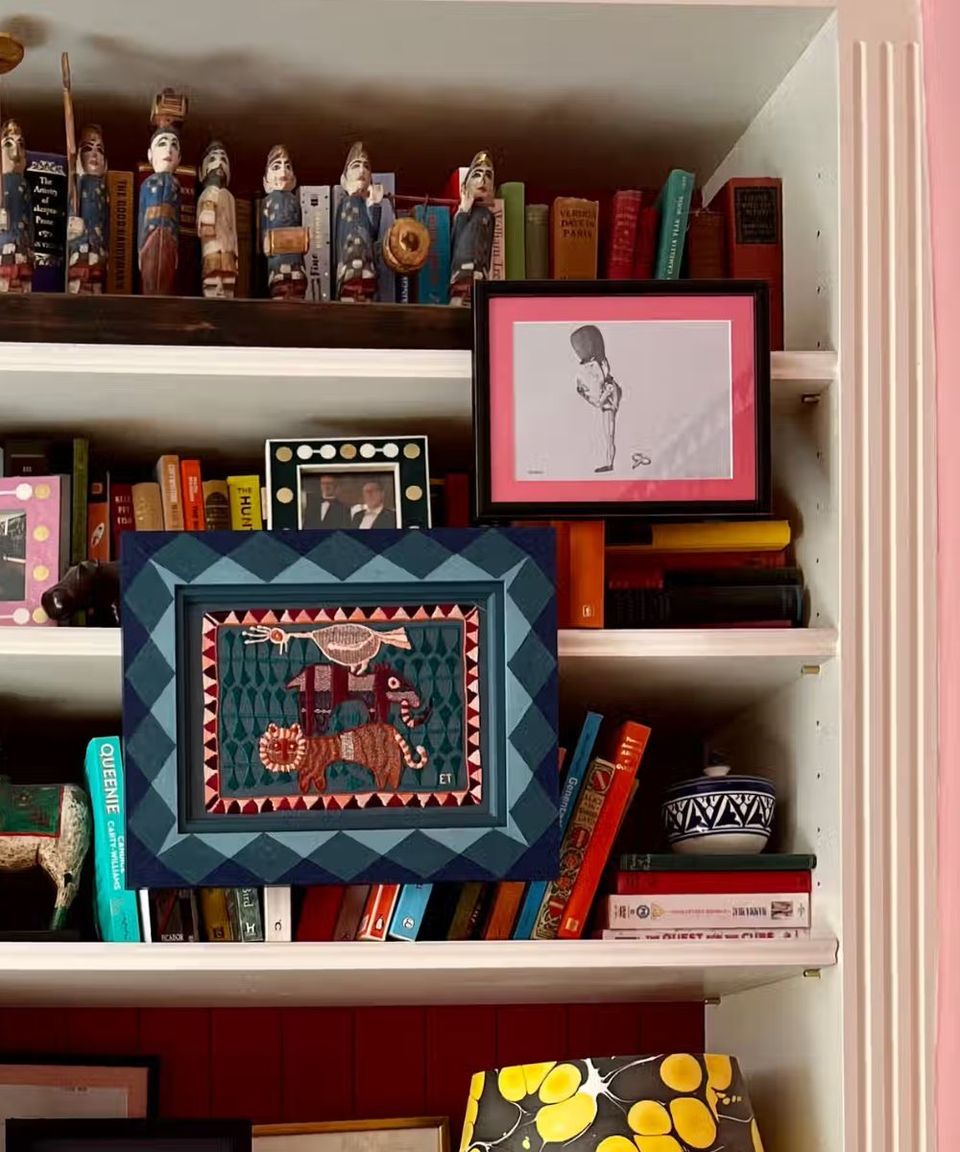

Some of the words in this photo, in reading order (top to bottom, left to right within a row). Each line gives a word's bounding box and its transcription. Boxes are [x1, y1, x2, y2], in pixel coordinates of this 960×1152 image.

[39, 176, 53, 185] The
[99, 743, 121, 815] QUEENIE
[438, 772, 453, 786] ET
